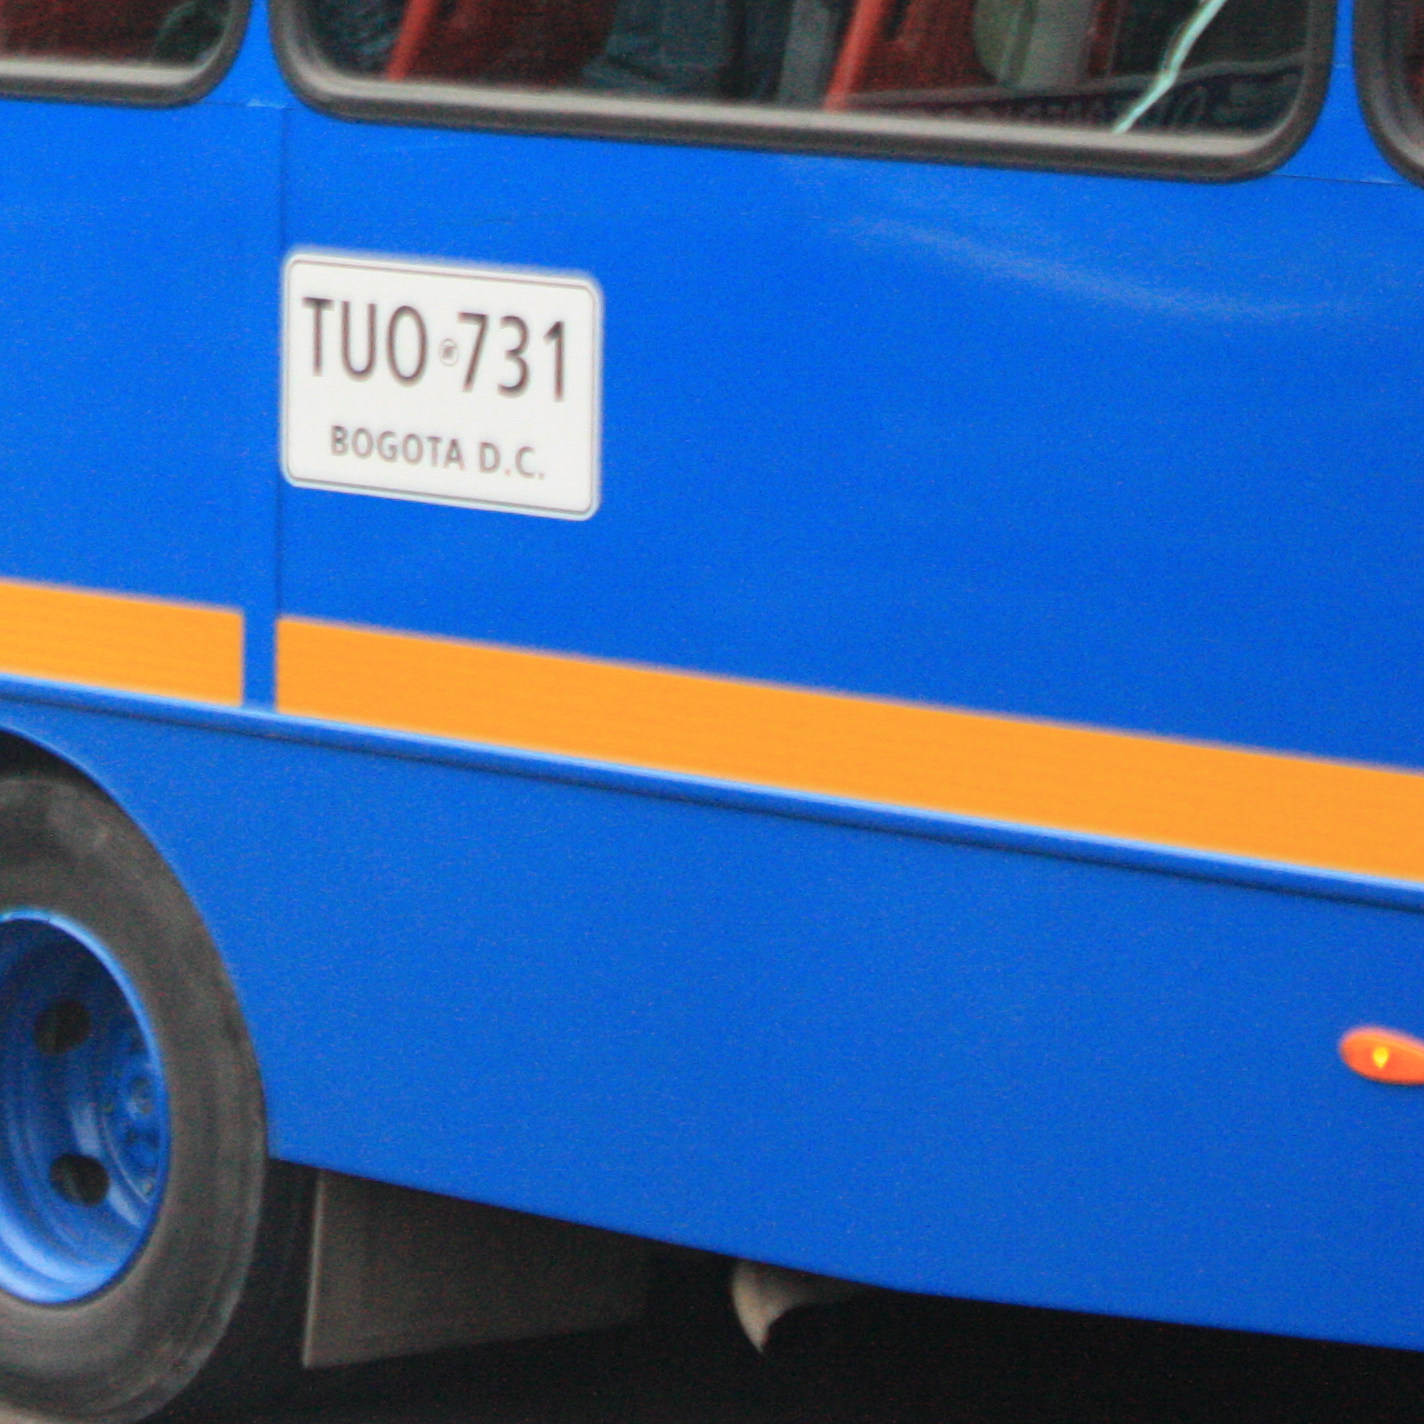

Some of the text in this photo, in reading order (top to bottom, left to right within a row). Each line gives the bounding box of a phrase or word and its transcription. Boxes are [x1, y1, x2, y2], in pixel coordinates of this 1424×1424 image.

[302, 296, 566, 404] TUO 731
[330, 424, 546, 481] BOGOTA D.C.
